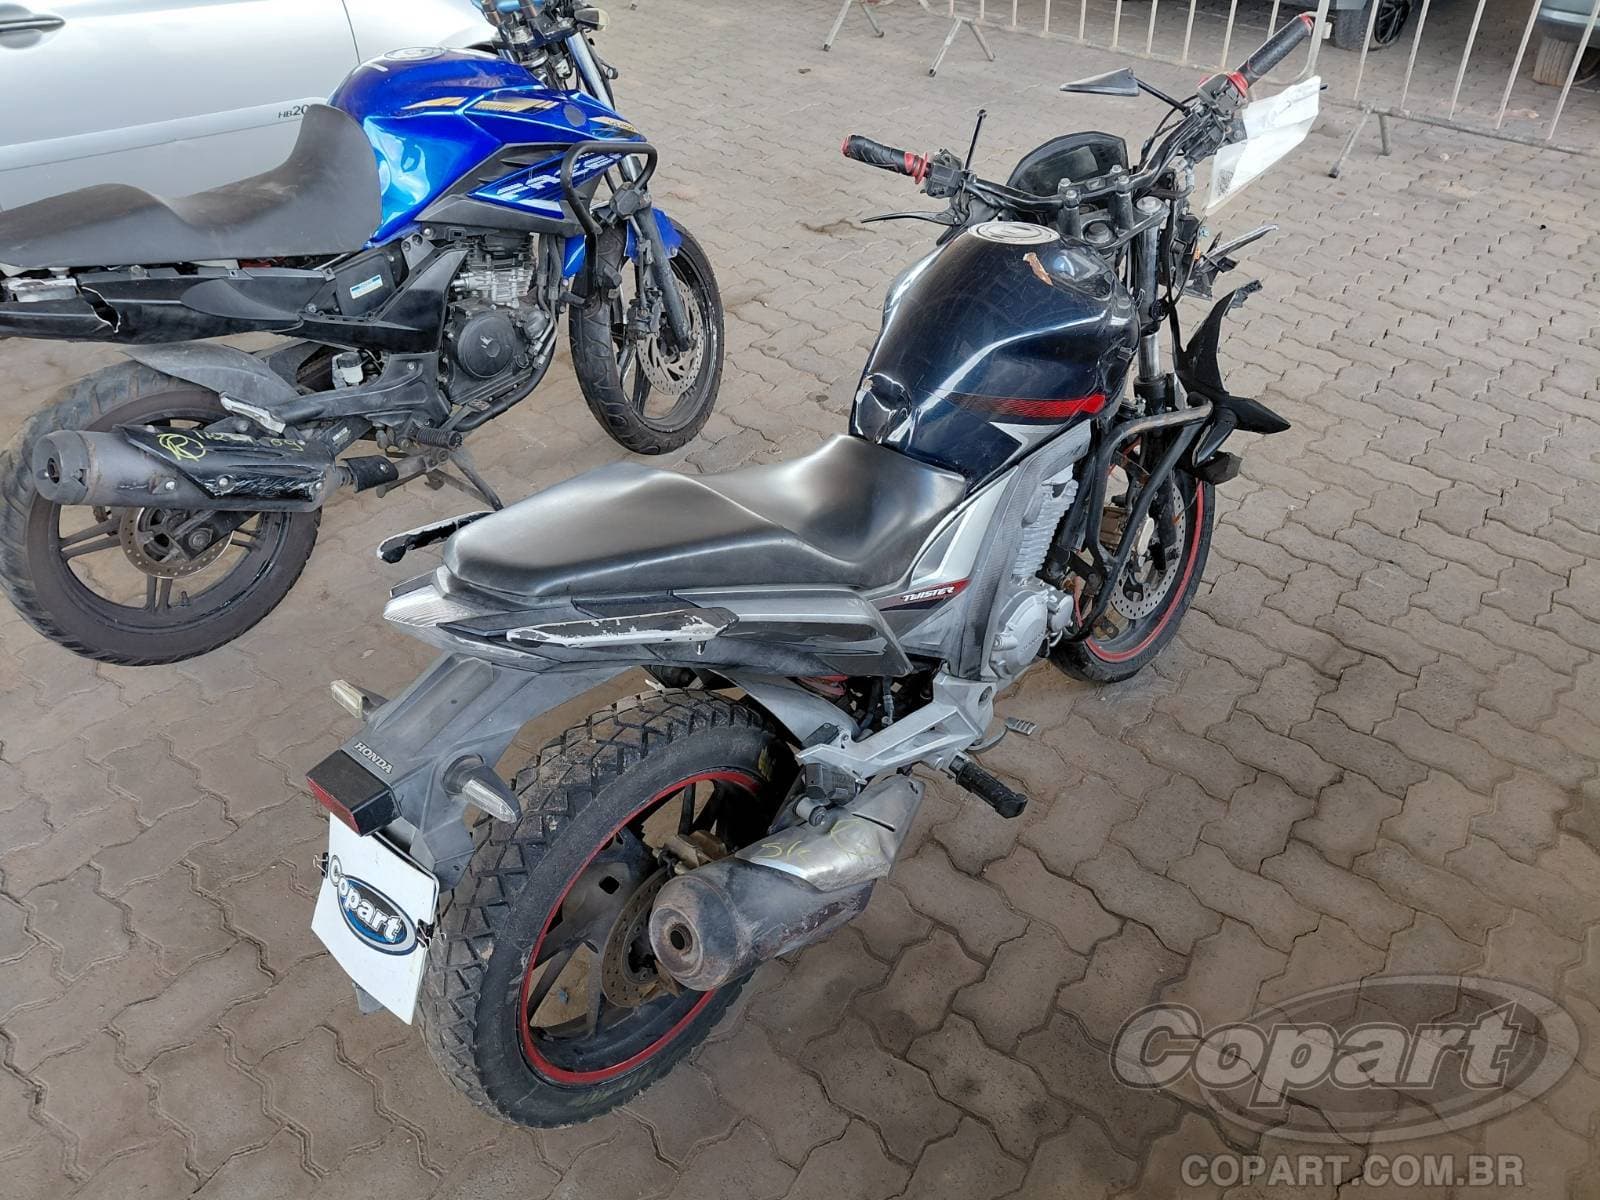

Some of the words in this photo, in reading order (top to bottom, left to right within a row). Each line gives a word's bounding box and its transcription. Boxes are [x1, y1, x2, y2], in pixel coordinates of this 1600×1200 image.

[903, 586, 955, 602] TWISTER
[354, 741, 394, 774] HONDA
[329, 854, 402, 943] Copart
